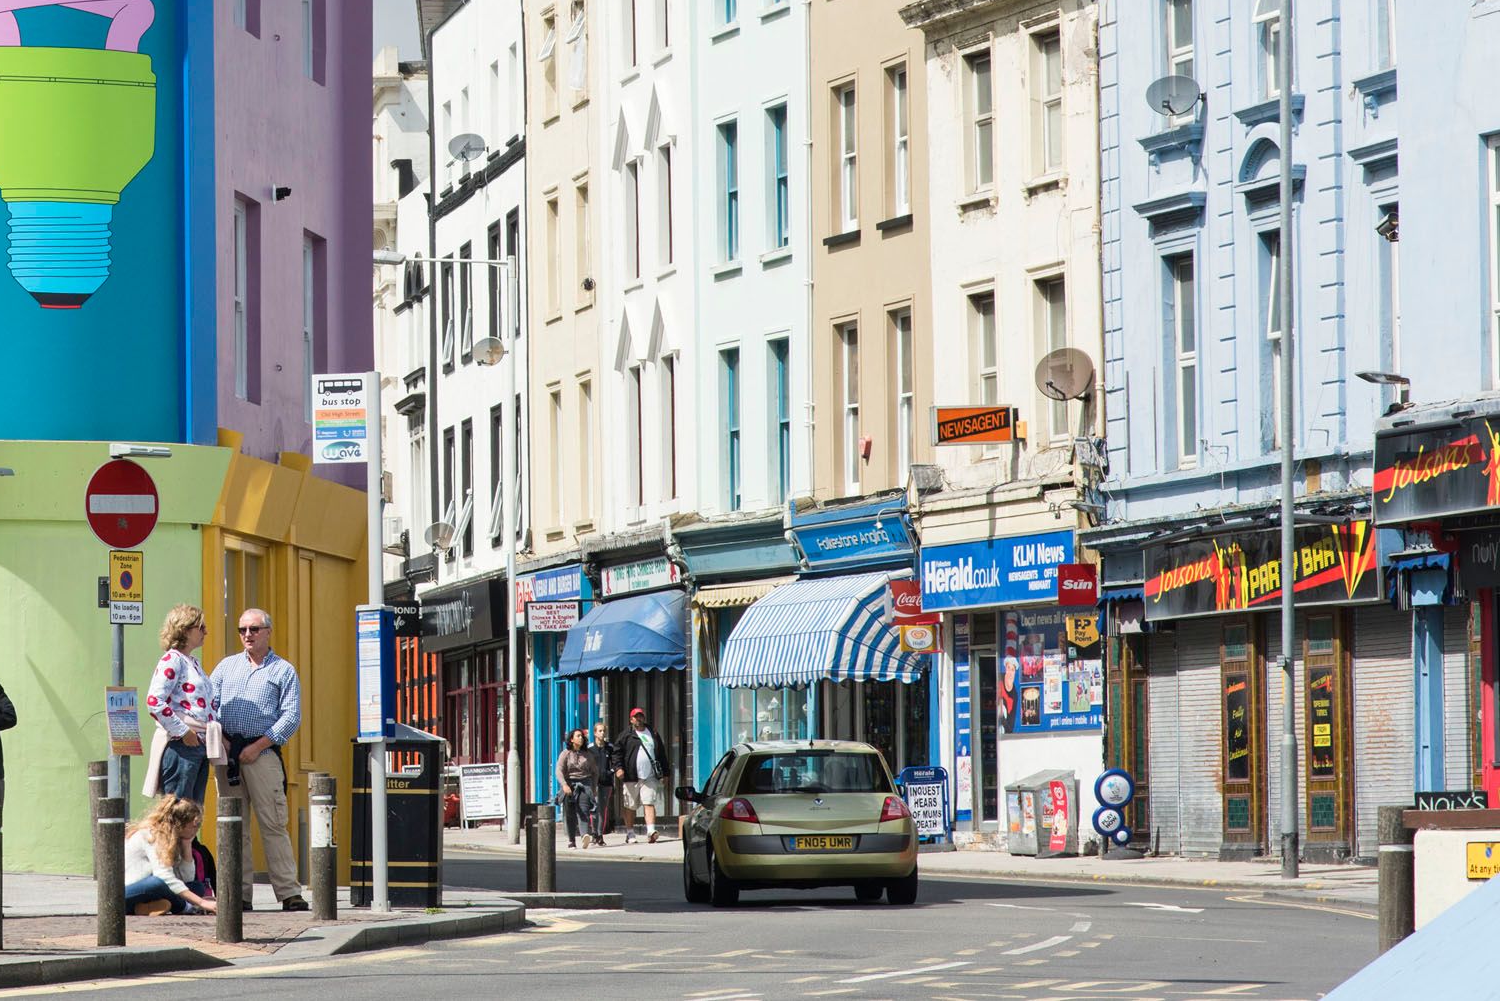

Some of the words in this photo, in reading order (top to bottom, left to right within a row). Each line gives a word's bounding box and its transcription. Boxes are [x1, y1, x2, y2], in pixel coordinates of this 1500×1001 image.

[321, 398, 338, 406] bus
[340, 398, 361, 407] stop
[939, 411, 1006, 439] NEWSAGENT
[816, 533, 859, 551] Folkestone
[859, 528, 890, 545] Angling
[113, 554, 140, 562] Pedestrian
[1012, 544, 1035, 568] KLM
[1036, 542, 1066, 565] News
[924, 556, 1001, 594] Herald.co.uk
[1154, 557, 1213, 603] Jolsons
[1301, 536, 1336, 577] BAR
[1008, 570, 1039, 583] NEWSAGENTS
[1062, 579, 1093, 591] Sun
[122, 604, 140, 612] loading
[387, 779, 410, 789] itter
[909, 785, 941, 797] INQUEST
[913, 797, 938, 808] HEARS
[912, 810, 921, 819] OF
[922, 809, 942, 819] MUMS
[1101, 813, 1114, 825] PLAY
[916, 820, 938, 829] DEATH
[1105, 816, 1117, 829] NOW
[796, 837, 827, 848] FN05
[829, 837, 852, 848] UMR
[1470, 864, 1478, 873] At
[1479, 865, 1492, 875] any
